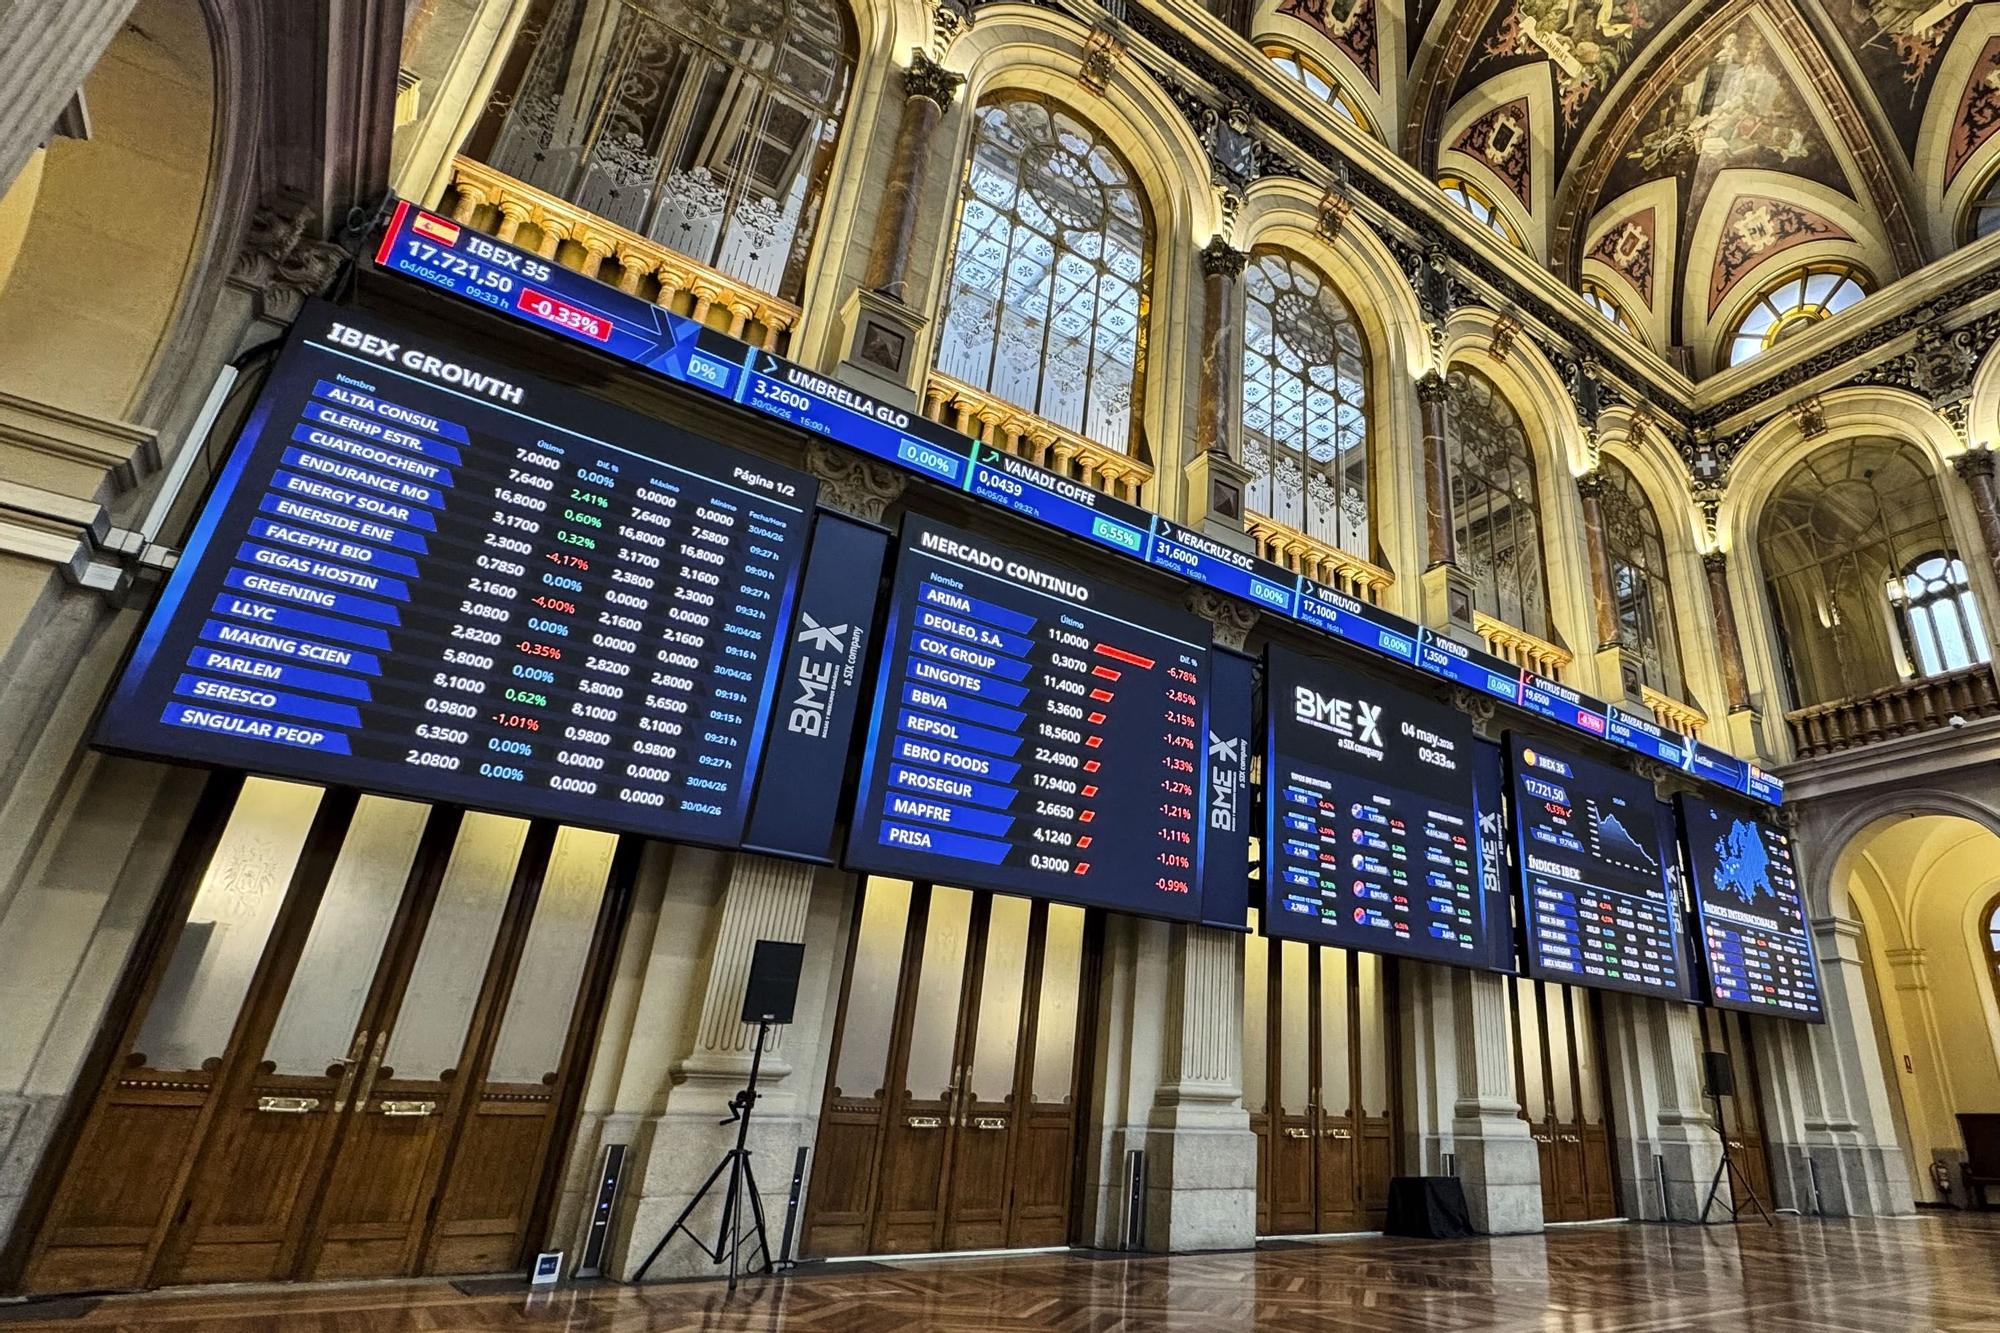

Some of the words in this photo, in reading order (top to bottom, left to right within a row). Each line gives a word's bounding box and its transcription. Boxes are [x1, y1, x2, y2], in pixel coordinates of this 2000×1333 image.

[400, 260, 454, 286] 04/05/26
[466, 286, 498, 303] 09:33
[409, 241, 512, 292] 17.721,50
[467, 237, 522, 270] IBEX
[522, 261, 550, 281] 35
[531, 301, 599, 335] -0,33%
[327, 322, 400, 361] IBEX
[402, 351, 523, 404] GROWTH
[337, 374, 375, 391] Nombre
[752, 398, 790, 418] 30/04/26
[755, 380, 809, 410] 3,2600
[788, 369, 873, 415] UMBRELLA
[877, 407, 908, 428] GLO
[320, 410, 381, 435] CLERHP
[382, 430, 422, 450] ESTR.
[509, 469, 553, 490] 7,6400
[571, 489, 608, 507] 2,41%
[328, 389, 375, 411] ALTIA
[378, 404, 439, 432] CONSUL
[517, 448, 560, 470] 7,0000
[578, 469, 614, 487] 0,00%
[907, 446, 949, 473] 0,00%
[298, 454, 400, 492] ENDURANCE
[401, 485, 429, 500] MO
[493, 512, 539, 533] 3,1700
[558, 531, 595, 549] 0,32%
[310, 432, 439, 478] CUATROOCHENT
[495, 488, 547, 511] 16,8000
[565, 510, 601, 528] 0,60%
[733, 467, 774, 490] Página
[777, 483, 795, 496] 1/2
[980, 471, 1022, 496] 0,0439
[1004, 459, 1056, 489] VANADI
[1057, 482, 1095, 506] COFFE
[277, 501, 360, 532] ENERSIDE
[361, 524, 394, 541] ENE
[477, 556, 524, 576] 0,7850
[543, 573, 582, 592] 0,00%
[287, 478, 356, 504] ENERGY
[355, 497, 409, 520] SOLAR
[484, 534, 532, 554] 2,3000
[546, 553, 588, 570] -4,17%
[1099, 523, 1134, 546] 6,55%
[1178, 530, 1231, 562] VERACRUZ
[1232, 552, 1254, 571] SOC
[266, 525, 340, 553] FACEPHI
[340, 545, 372, 561] BIO
[468, 578, 517, 599] 2,1600
[532, 597, 575, 614] -4,00%
[922, 532, 1003, 571] MERCADO
[1006, 563, 1088, 601] CONTINUO
[1157, 542, 1198, 566] 31,6000
[243, 576, 336, 606] GREENING
[451, 625, 501, 645] 2,8200
[516, 641, 561, 660] -0,35%
[255, 550, 311, 572] GIGAS
[312, 564, 378, 589] HOSTIN
[460, 601, 509, 621] 3,0800
[529, 618, 568, 636] 0,00%
[931, 573, 963, 589] Nombre
[1061, 615, 1084, 629] Último
[1255, 584, 1285, 605] 0,00%
[1304, 600, 1336, 621] 17,1000
[1319, 588, 1361, 613] VITRUVIO
[231, 601, 276, 620] LLYC
[443, 649, 493, 669] 5,8000
[513, 665, 553, 683] 0,00%
[848, 625, 864, 664] company
[924, 614, 978, 641] DEOLEO,
[981, 631, 1003, 647] S.A.
[1052, 653, 1087, 672] 0,3070
[1166, 690, 1196, 705] -2,85%
[927, 590, 970, 612] ARIMA
[1049, 629, 1088, 649] 11,0000
[1167, 667, 1196, 683] -6,78%
[1383, 636, 1408, 654] 0,00%
[1424, 649, 1448, 665] 1,3500
[1437, 637, 1468, 658] VIVENIO
[207, 654, 282, 679] PARLEM
[425, 698, 477, 718] 0,9800
[493, 714, 539, 731] -1,01%
[219, 627, 297, 653] MAKING
[298, 644, 351, 665] SCIEN
[434, 673, 485, 693] 8,1000
[506, 689, 546, 706] 0,62%
[788, 655, 832, 737] BME
[843, 663, 855, 679] SIX
[920, 639, 948, 656] COX
[950, 648, 995, 669] GROUP
[1044, 675, 1084, 695] 11,4000
[1165, 711, 1195, 727] -2,15%
[193, 682, 276, 707] SERESCO
[416, 724, 468, 744] 6,3500
[489, 738, 531, 756] 0,00%
[912, 689, 947, 709] BBVA
[1040, 724, 1080, 743] 18,5600
[1163, 757, 1193, 772] -1,33%
[916, 663, 980, 691] LINGOTES
[1047, 700, 1082, 719] 5,3600
[1164, 734, 1193, 749] -1,47%
[1296, 685, 1353, 731] BME
[1401, 721, 1415, 738] 04
[181, 710, 272, 737] SNGULAR
[274, 727, 324, 745] PEOP
[406, 750, 460, 769] 2,0800
[480, 764, 523, 781] 0,00%
[908, 716, 958, 739] REPSOL
[1036, 748, 1078, 768] 22,4900
[1161, 780, 1192, 795] -1,27%
[1344, 739, 1355, 752] SIX
[1355, 743, 1384, 762] company
[1539, 756, 1556, 771] IBEX
[899, 771, 971, 797] PROSEGUR
[1036, 801, 1074, 819] 2,6650
[1159, 829, 1190, 843] -1,11%
[903, 743, 940, 762] EBRO
[943, 752, 989, 773] FOODS
[1034, 774, 1076, 793] 17,9400
[1160, 804, 1191, 819] -1,21%
[1211, 765, 1232, 831] BME
[1526, 779, 1564, 801] 17.721,50
[890, 828, 931, 847] PRISA
[1031, 855, 1069, 872] 0,3000
[1156, 878, 1188, 893] -0,99%
[894, 799, 951, 821] MAPFRE
[1033, 828, 1071, 845] 4,1240
[1157, 853, 1189, 868] -1,01%
